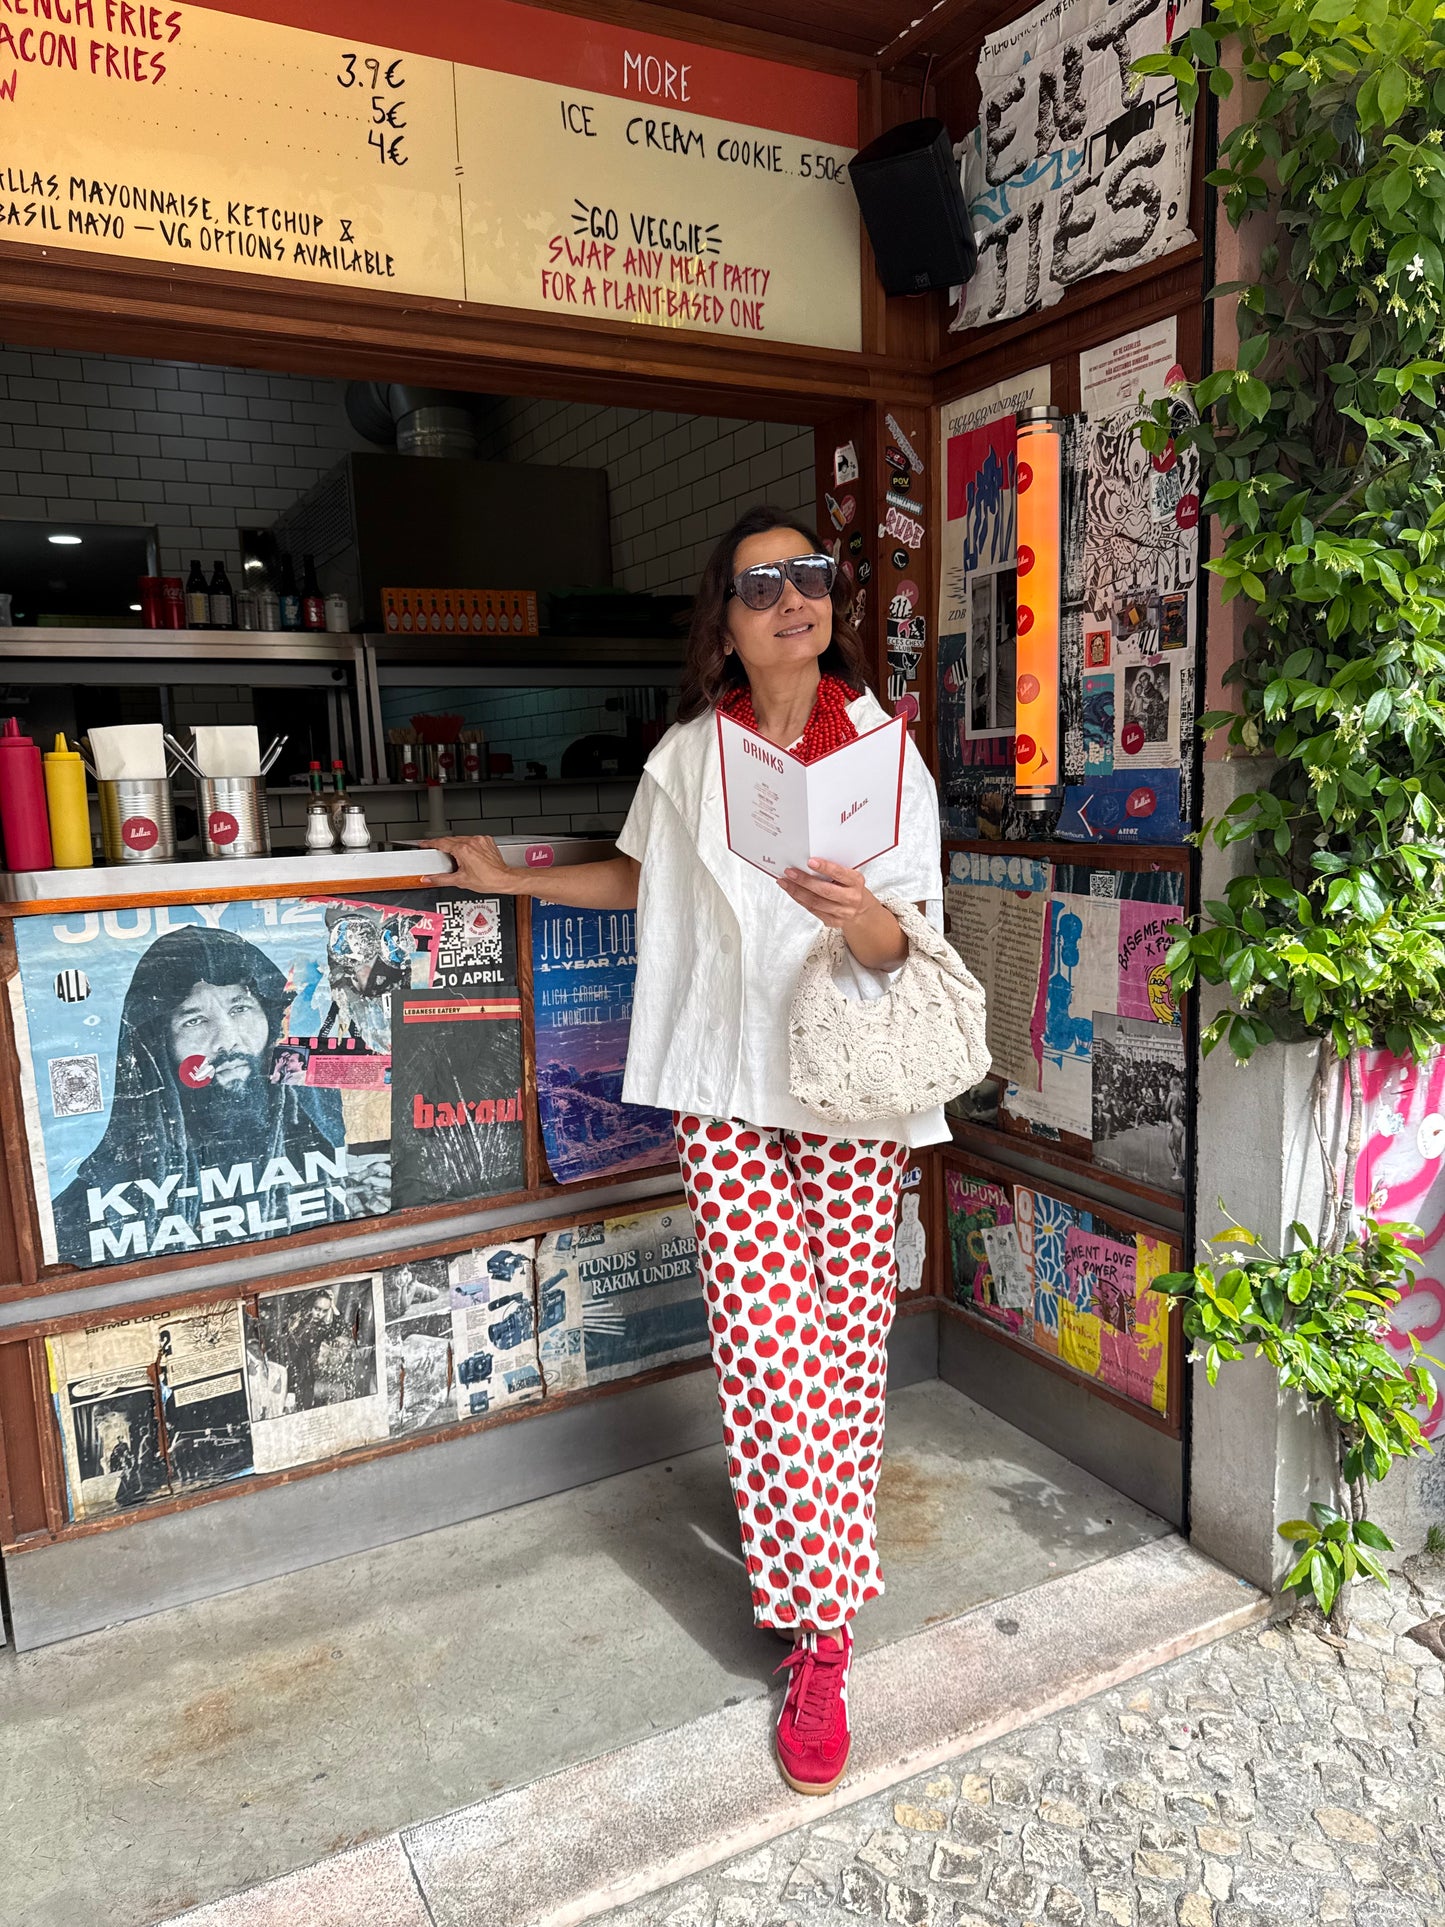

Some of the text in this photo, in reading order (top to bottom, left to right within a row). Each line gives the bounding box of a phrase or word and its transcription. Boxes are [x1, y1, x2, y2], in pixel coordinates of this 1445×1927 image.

[106, 0, 182, 43] FRIES
[90, 40, 167, 84] FRIES
[337, 54, 406, 90] 3.9€
[624, 49, 692, 102] MORE
[371, 96, 407, 129] 5€
[368, 130, 409, 165] 4€
[561, 100, 597, 136] ICE
[626, 117, 704, 158] CREAM
[717, 137, 782, 173] COOKIE
[69, 176, 218, 222] MAYONNAISE,
[227, 201, 324, 237] KETCHUP
[68, 208, 125, 239] MAYO
[160, 219, 191, 249] VG
[200, 226, 285, 262] OPTIONS
[293, 242, 396, 277] AVAILABLE
[591, 207, 704, 255] GO VEGGIE
[549, 235, 771, 297] SWAP ANY MEAT PATTY
[542, 270, 764, 331] FOR A PLANT-BASED ONE
[948, 387, 1034, 431] CICLO CONUNDRUM
[948, 608, 967, 621] ZDB
[742, 738, 784, 774] DRINKS
[53, 901, 233, 944] JULY
[251, 898, 326, 927] 12
[540, 916, 584, 960] JUST
[1145, 943, 1156, 957] X
[462, 969, 505, 985] APRIL
[540, 958, 610, 972] 1-YEAR
[404, 1006, 462, 1016] LEBANESE EATERY
[542, 984, 608, 1006] ALICIA CARRERA
[86, 1147, 348, 1222] KY-MAN
[88, 1186, 350, 1263] MARLEY
[1082, 1260, 1118, 1282] POWER
[1105, 1248, 1136, 1268] LOVE
[591, 1259, 692, 1296] RAKIM UNDER
[85, 1311, 171, 1336] RITMO LOCO
